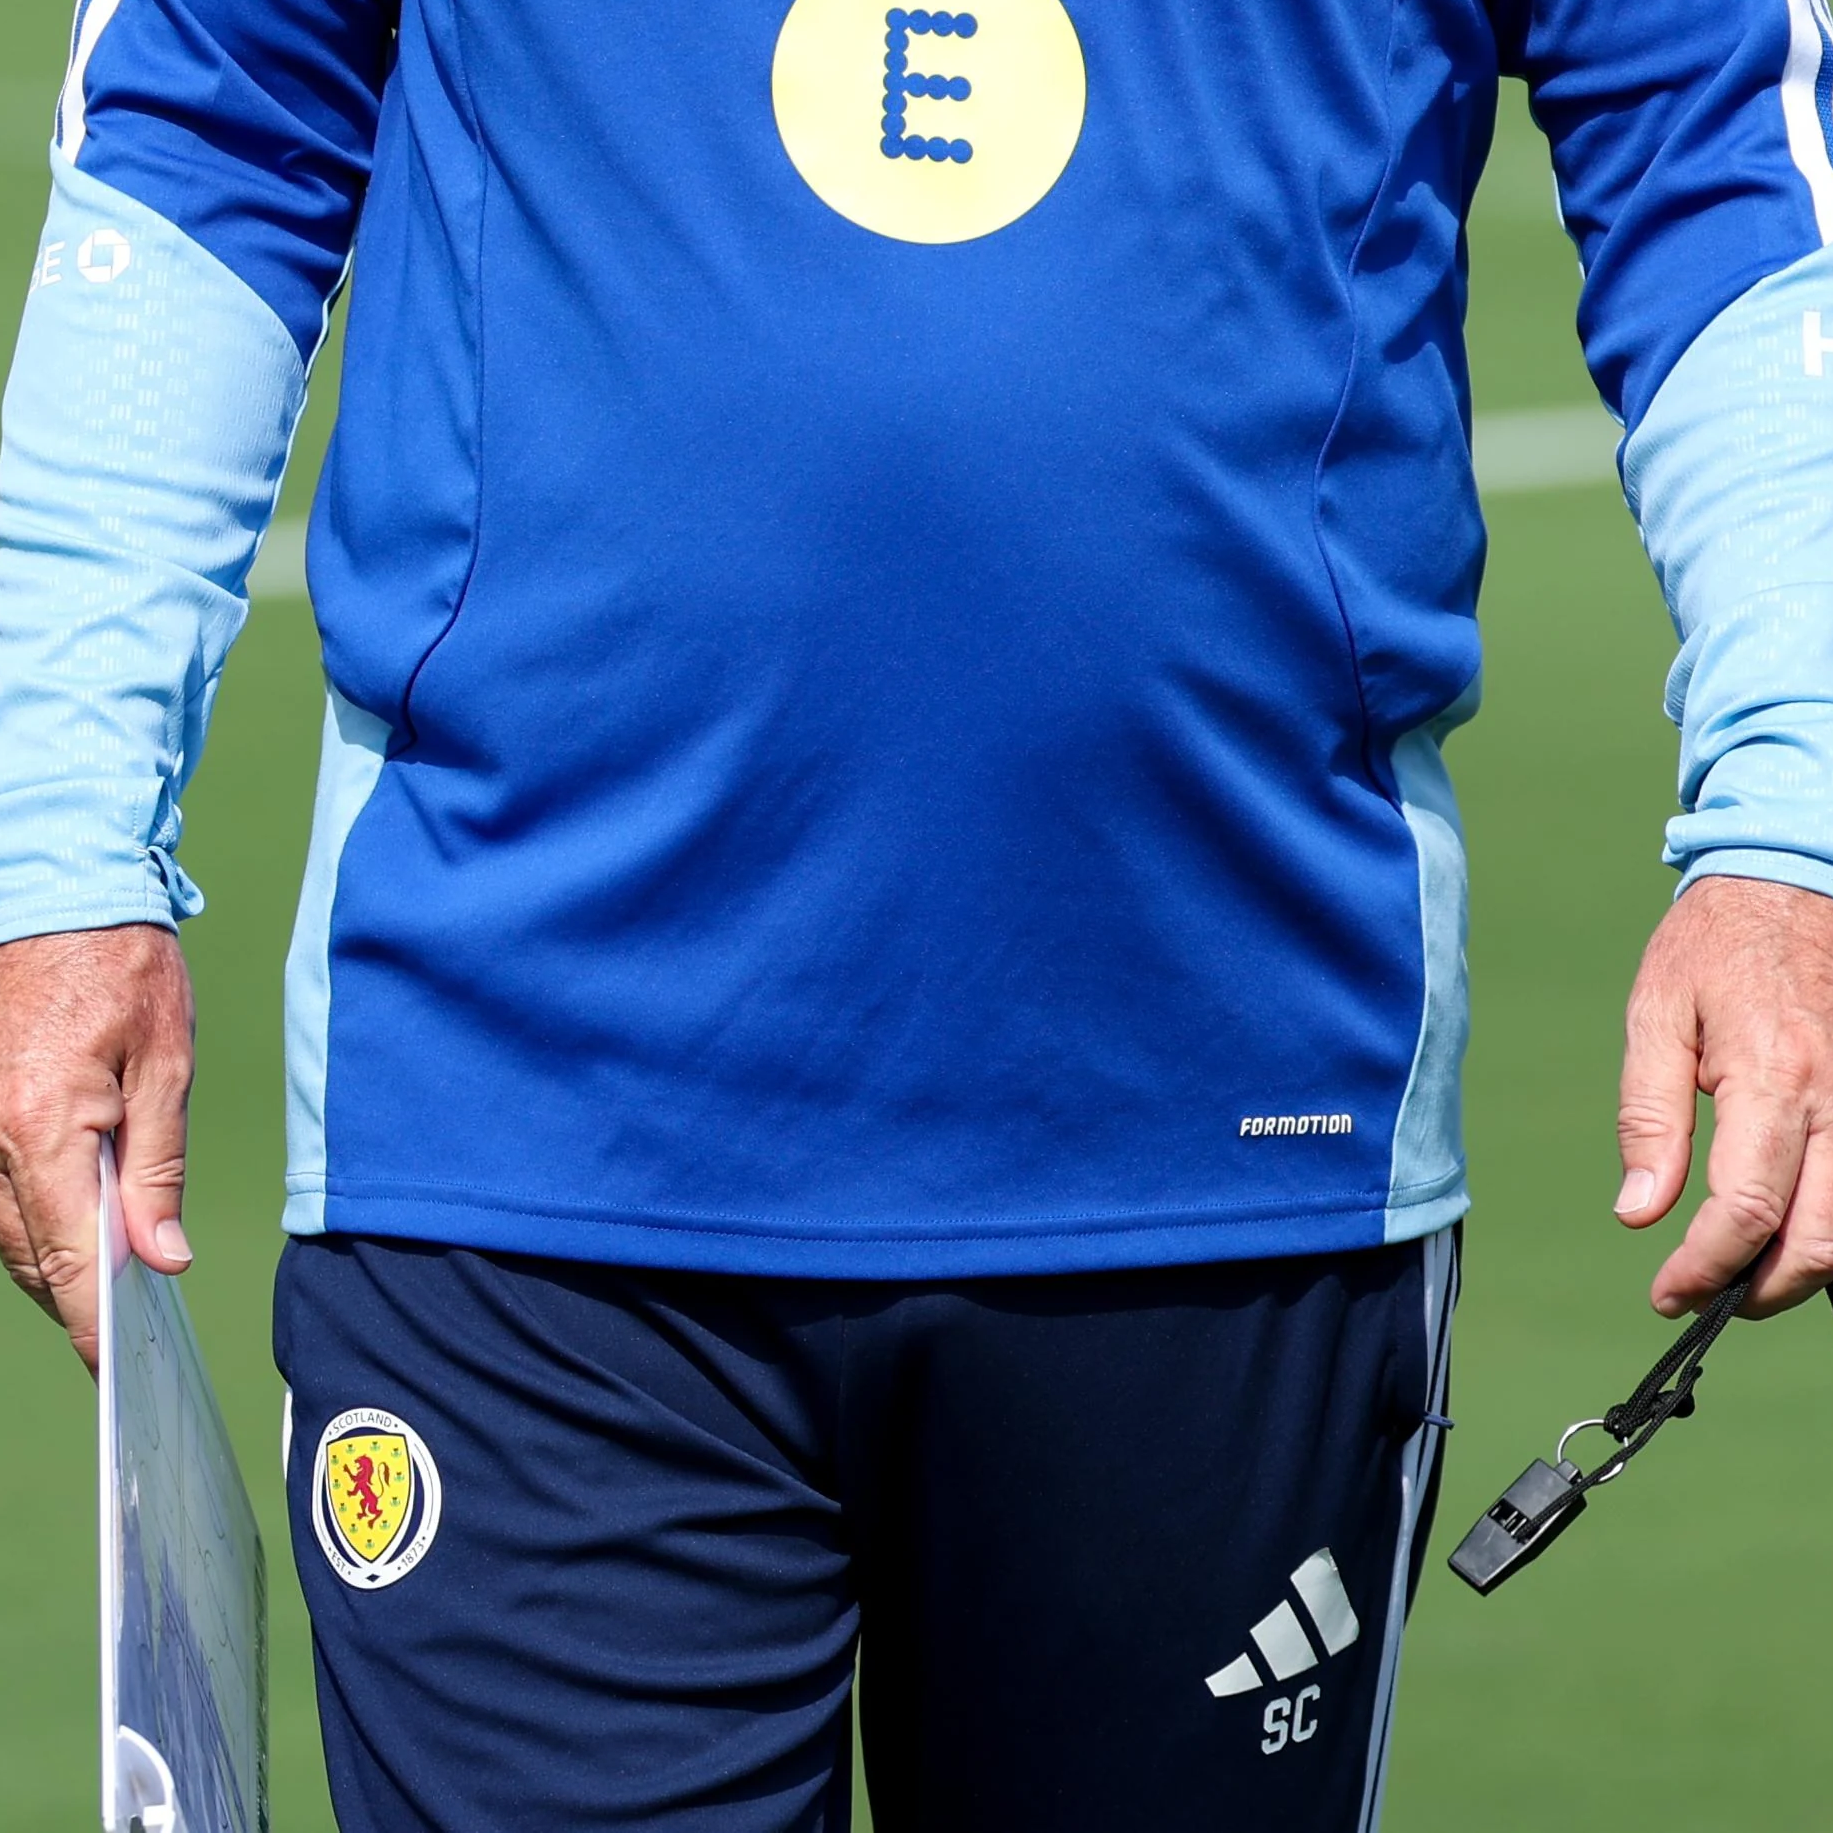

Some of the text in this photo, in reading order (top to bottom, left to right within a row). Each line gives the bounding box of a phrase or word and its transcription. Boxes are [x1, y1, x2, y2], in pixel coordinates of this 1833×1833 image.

[1239, 1114, 1352, 1137] FORMOTION
[332, 1412, 393, 1433] SCOTLAND
[330, 1551, 346, 1572] EST
[401, 1541, 425, 1568] 1873
[1261, 1683, 1321, 1755] SC
